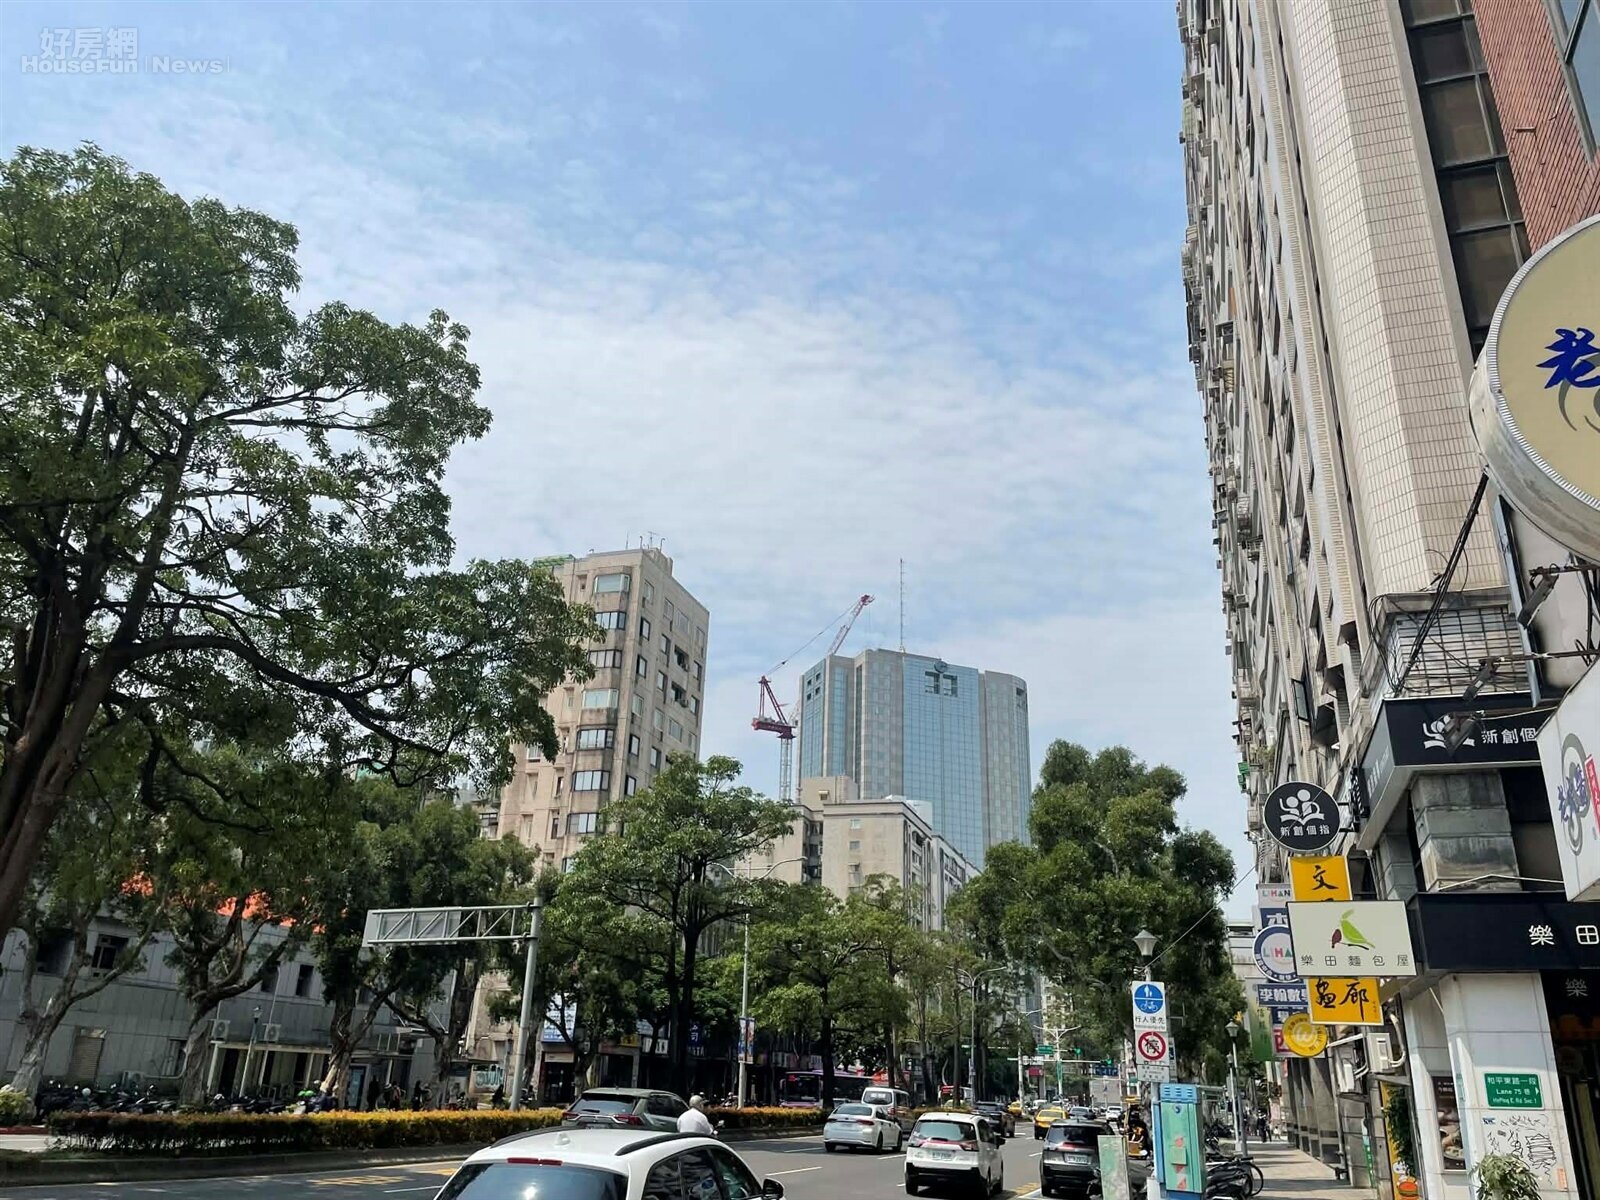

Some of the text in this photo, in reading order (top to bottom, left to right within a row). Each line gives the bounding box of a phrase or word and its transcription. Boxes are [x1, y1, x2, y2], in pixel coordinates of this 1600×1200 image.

[1528, 924, 1600, 946] 樂田
[1300, 953, 1409, 967] 樂田麵包屋
[1564, 977, 1589, 997] 樂
[1487, 1076, 1537, 1086] 和平東路一段
